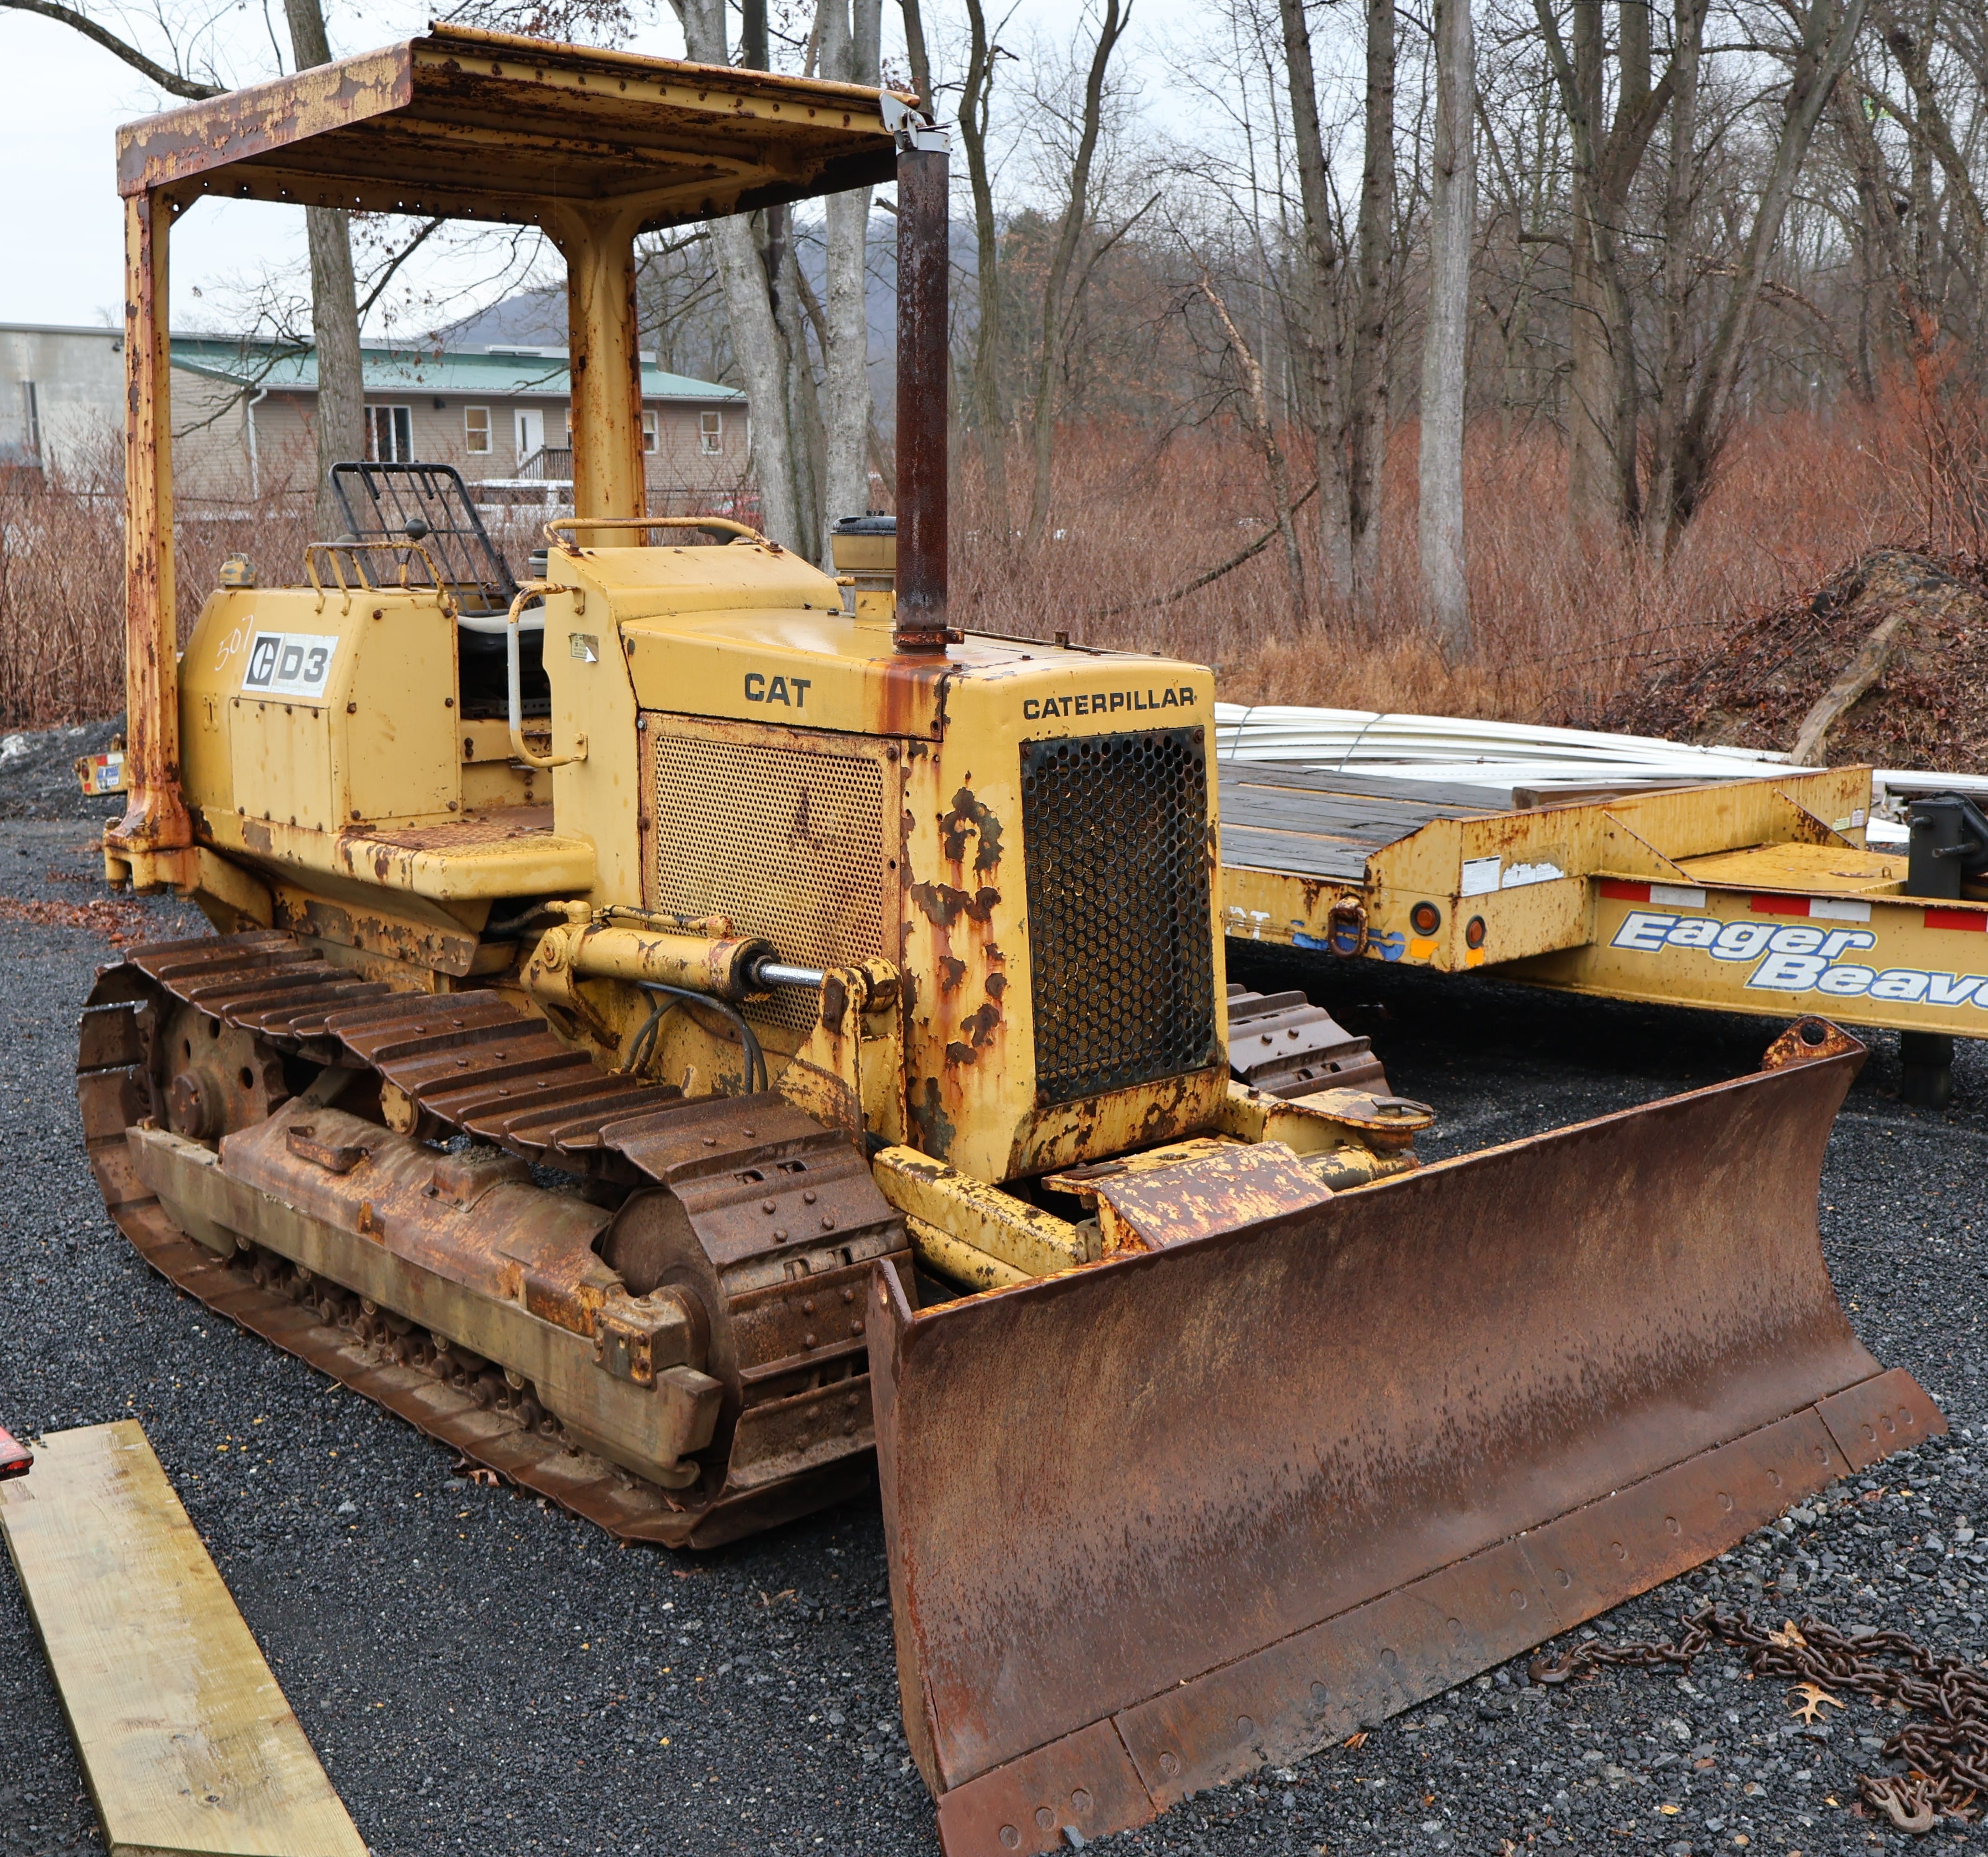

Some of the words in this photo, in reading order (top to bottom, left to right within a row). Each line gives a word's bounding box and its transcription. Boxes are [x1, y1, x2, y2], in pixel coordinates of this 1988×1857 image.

[278, 645, 328, 682] D3
[745, 673, 811, 708] CAT
[1023, 687, 1194, 720] CATERPILLAR
[1610, 910, 1876, 961] Eager
